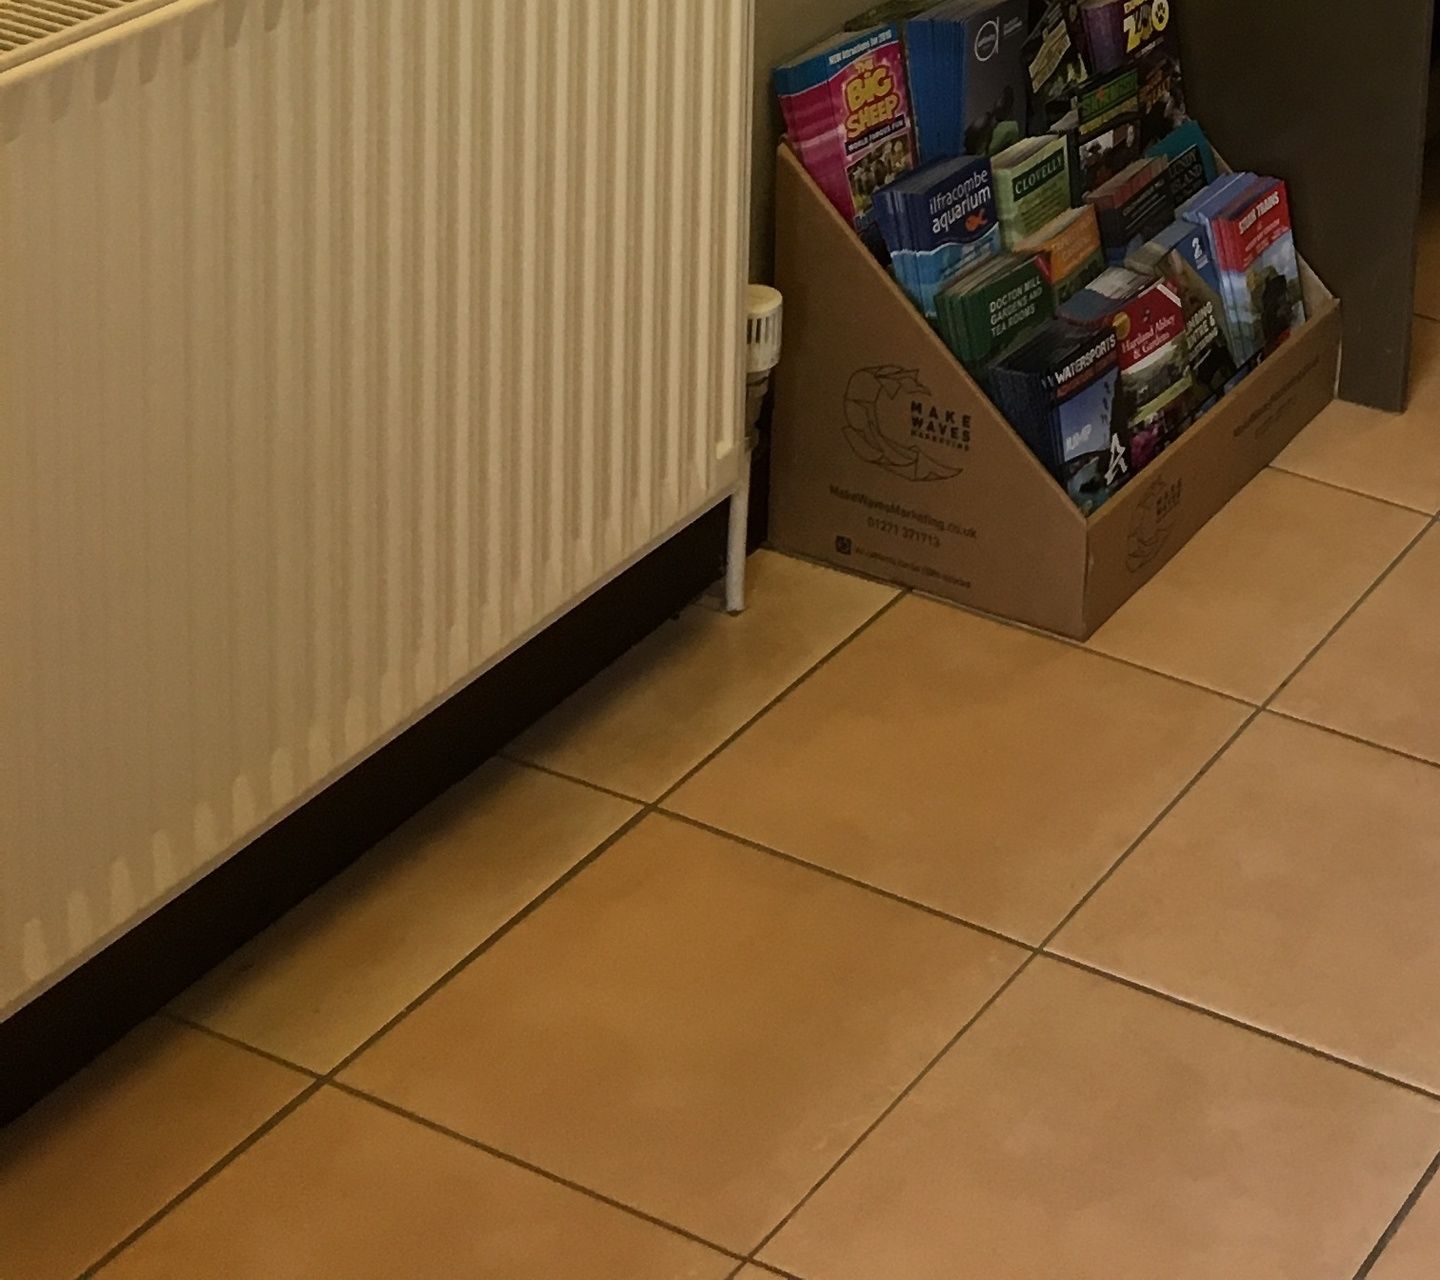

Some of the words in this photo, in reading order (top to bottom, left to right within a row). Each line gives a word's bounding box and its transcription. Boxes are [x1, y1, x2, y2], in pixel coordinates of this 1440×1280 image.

[847, 93, 900, 138] SHEEP
[1015, 155, 1063, 195] CLOVELLY
[932, 186, 991, 234] aquarium
[1192, 237, 1203, 260] 2
[990, 285, 1023, 313] DOCTON
[1024, 276, 1041, 289] MILL
[990, 297, 1028, 325] GARDENS
[1028, 286, 1043, 300] AND
[991, 320, 1007, 338] TEA
[1007, 303, 1036, 328] ROOMS
[1054, 333, 1117, 385] WATERSPORTS
[1133, 347, 1141, 360] &
[910, 400, 971, 429] MAKE
[910, 417, 971, 443] WAVES
[910, 429, 970, 452] MARKETING
[866, 516, 898, 536] 01271
